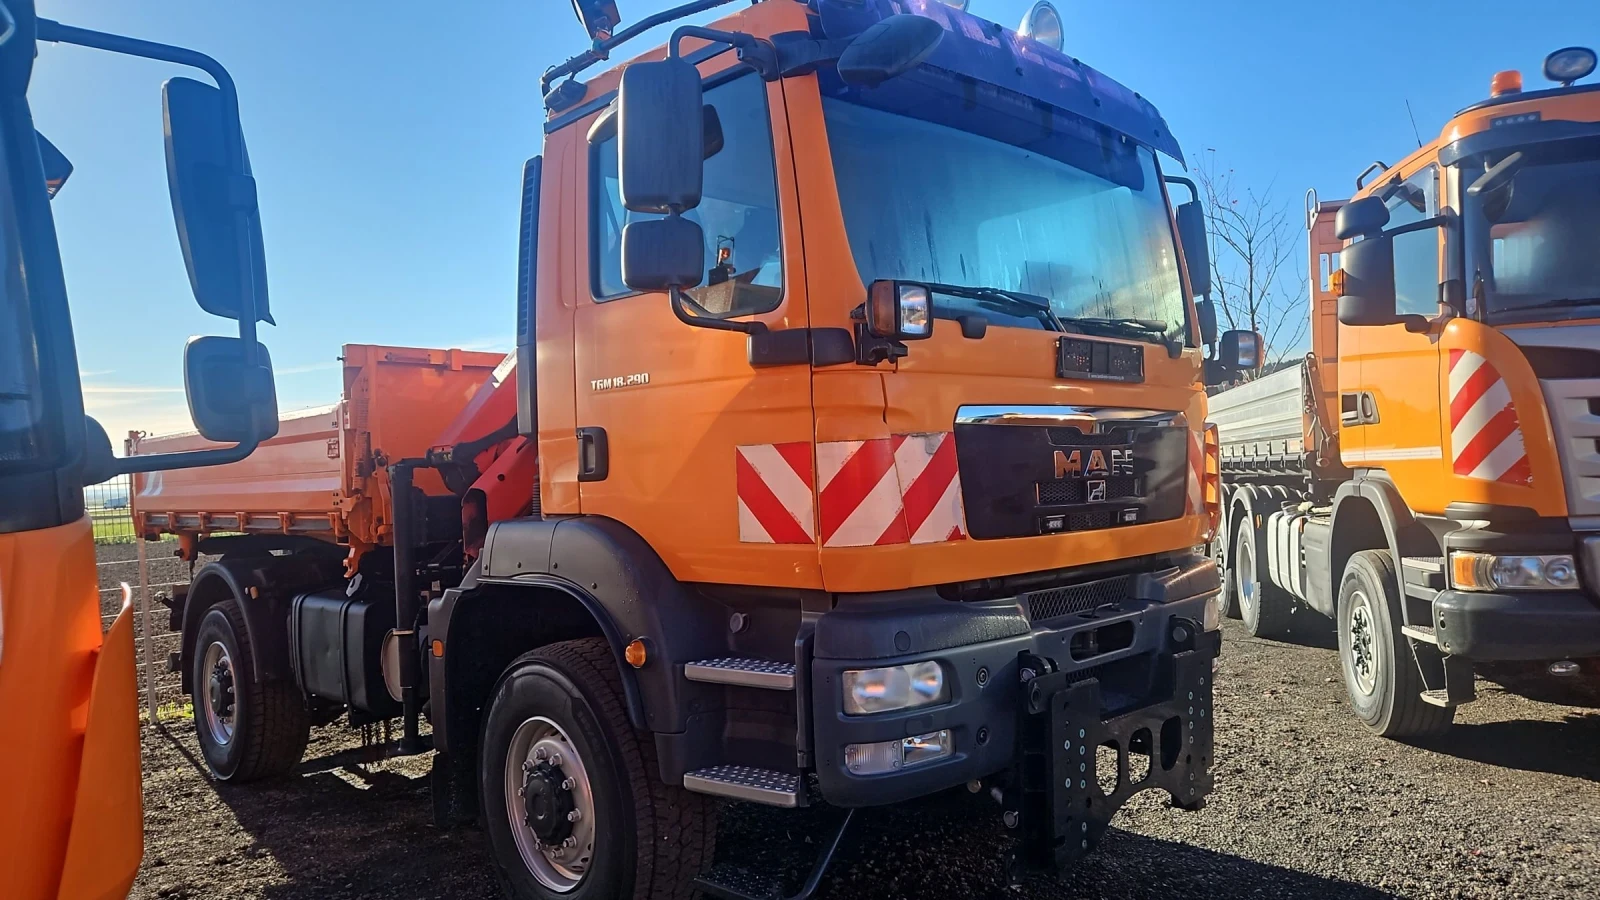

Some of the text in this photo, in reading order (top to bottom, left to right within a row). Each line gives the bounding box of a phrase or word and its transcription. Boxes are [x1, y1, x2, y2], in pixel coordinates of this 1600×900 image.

[590, 372, 650, 391] TGM 18.290
[1053, 449, 1133, 479] MAN
